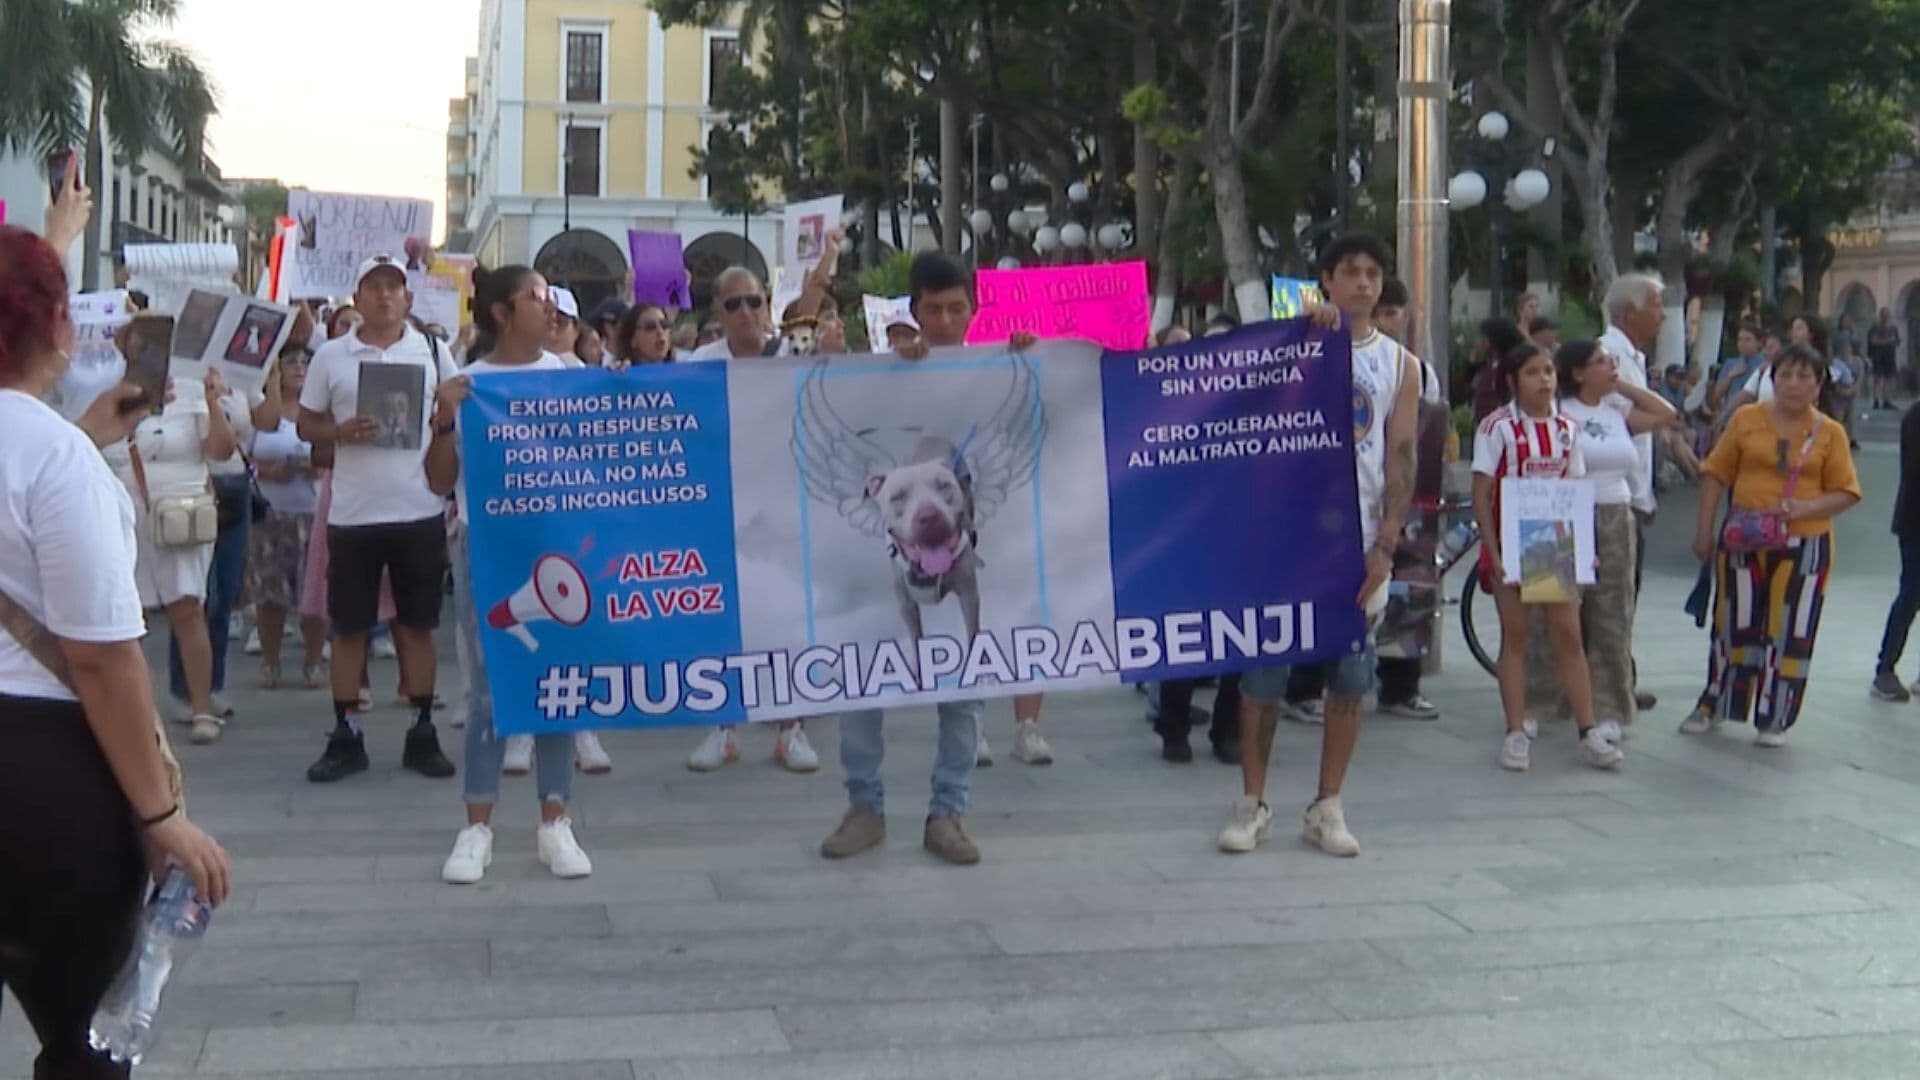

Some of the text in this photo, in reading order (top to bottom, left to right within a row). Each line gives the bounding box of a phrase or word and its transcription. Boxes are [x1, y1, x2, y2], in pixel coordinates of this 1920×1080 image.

[352, 197, 419, 233] BENJI
[1138, 342, 1325, 375] POR UN VERACRUZ
[1161, 367, 1304, 396] SIN VIOLENCIA
[509, 391, 675, 416] EXIGIMOS HAYA
[488, 414, 699, 443] PRONTA RESPUESTA
[1143, 411, 1326, 443] CERO TOLERANCIA
[506, 437, 683, 465] POR PARTE DE LA
[1128, 450, 1155, 468] AL
[1159, 441, 1262, 465] MALTRATO
[1266, 432, 1342, 452] ANIMAL
[605, 464, 636, 483] NO
[641, 459, 687, 480] MÁS
[485, 484, 708, 515] CASOS INCONCLUSOS
[620, 550, 707, 584] ALZA
[607, 585, 724, 622] LA VOZ
[536, 601, 1316, 720] #JUSTICIAPARABENJI
